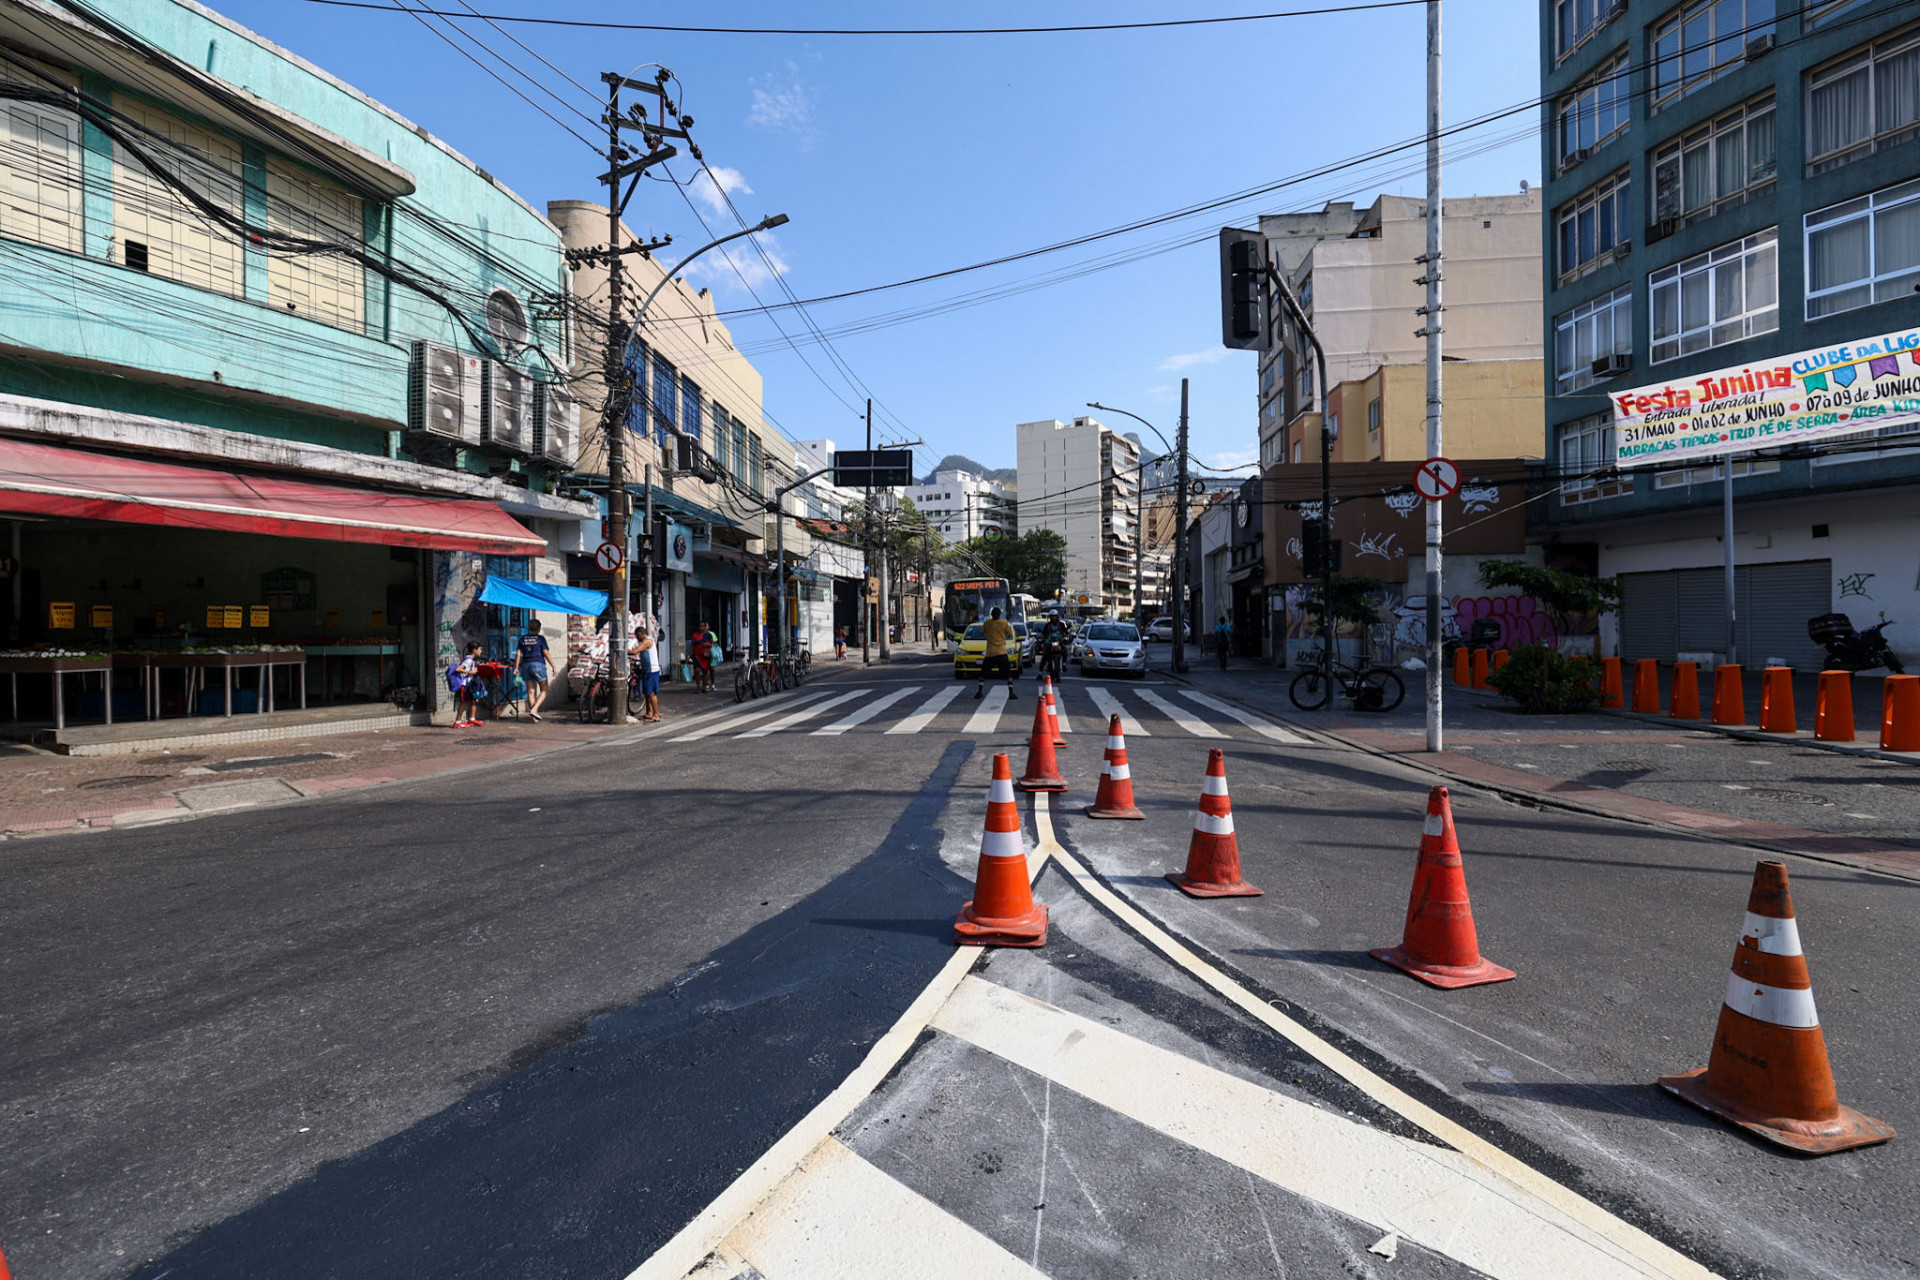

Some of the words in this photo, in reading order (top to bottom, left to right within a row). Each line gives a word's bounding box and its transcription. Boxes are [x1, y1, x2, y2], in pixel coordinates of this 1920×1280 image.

[1793, 347, 1853, 375] CLUBE
[1856, 343, 1883, 358] DA
[1617, 386, 1691, 416] Festa
[1696, 367, 1792, 403] Junina
[1727, 412, 1741, 425] de
[1744, 402, 1785, 423] JUNHO
[1806, 395, 1822, 411] 07
[1833, 390, 1852, 406] 09
[1854, 387, 1870, 402] de
[1873, 376, 1920, 399] JUNHO
[1619, 440, 1676, 459] BARRACAS
[1729, 426, 1755, 441] TRIO
[1759, 419, 1774, 436] PÉ
[1777, 419, 1793, 432] DE
[1797, 413, 1839, 430] SERRA
[1644, 407, 1691, 423] Entrada
